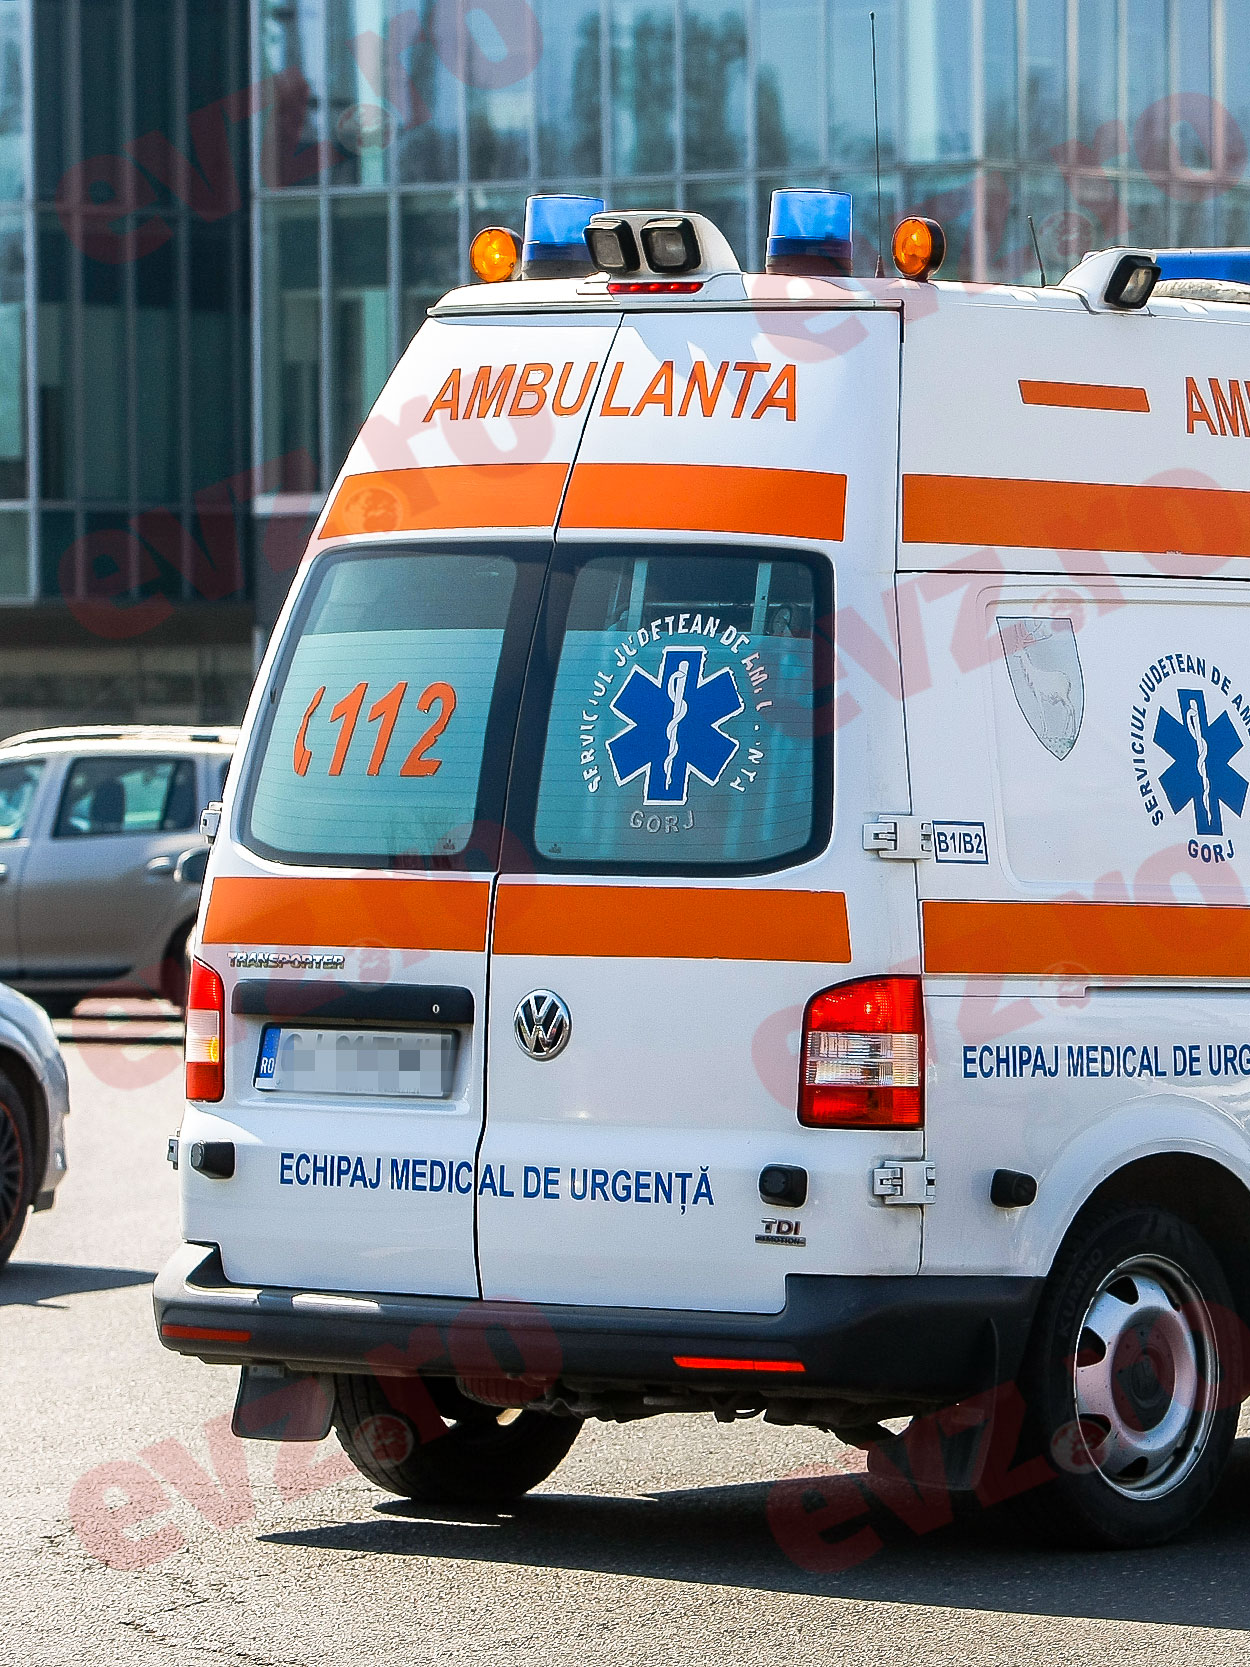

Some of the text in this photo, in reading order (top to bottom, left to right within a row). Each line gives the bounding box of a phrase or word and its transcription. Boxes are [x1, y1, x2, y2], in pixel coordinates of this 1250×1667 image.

[422, 361, 797, 423] AMBULANTA
[1138, 653, 1207, 703] JUDETEAN
[1211, 665, 1231, 696] DE
[328, 682, 457, 777] 112
[1130, 705, 1165, 827] SERVICIUL
[629, 810, 696, 834] GORJ
[1188, 838, 1235, 864] GORJ
[227, 952, 345, 969] TRANSPORTER
[260, 1057, 275, 1074] RO
[963, 1044, 1058, 1078] ECHIPAJ
[1067, 1044, 1167, 1078] MEDICAL
[1173, 1044, 1201, 1077] DE
[280, 1152, 715, 1215] ECHIPAJ MEDICAL DE URGENȚĂ
[761, 1218, 801, 1235] TDI
